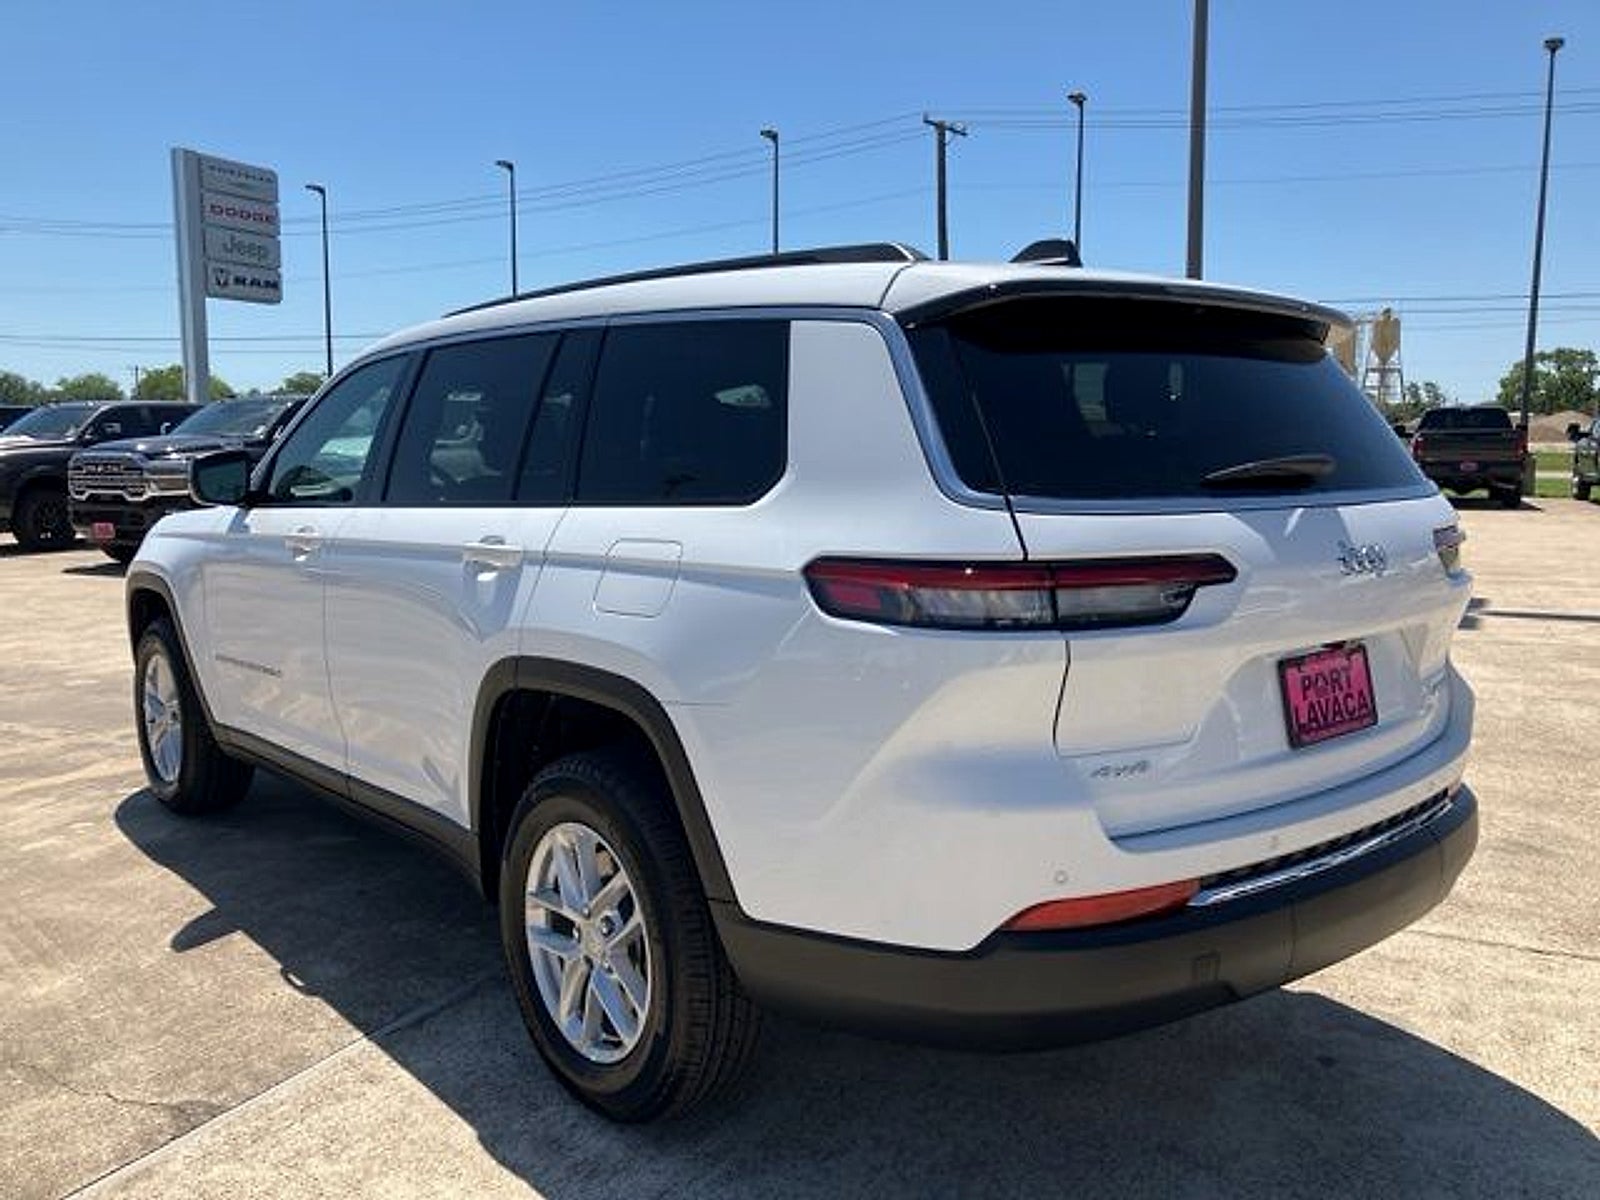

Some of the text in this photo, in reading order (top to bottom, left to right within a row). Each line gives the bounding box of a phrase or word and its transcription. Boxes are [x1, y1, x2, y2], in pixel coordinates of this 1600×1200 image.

[209, 204, 276, 224] DODGE
[222, 234, 269, 261] Jeep
[233, 274, 279, 289] RAM
[1301, 666, 1352, 701] PORT
[1295, 689, 1369, 735] LAVACA
